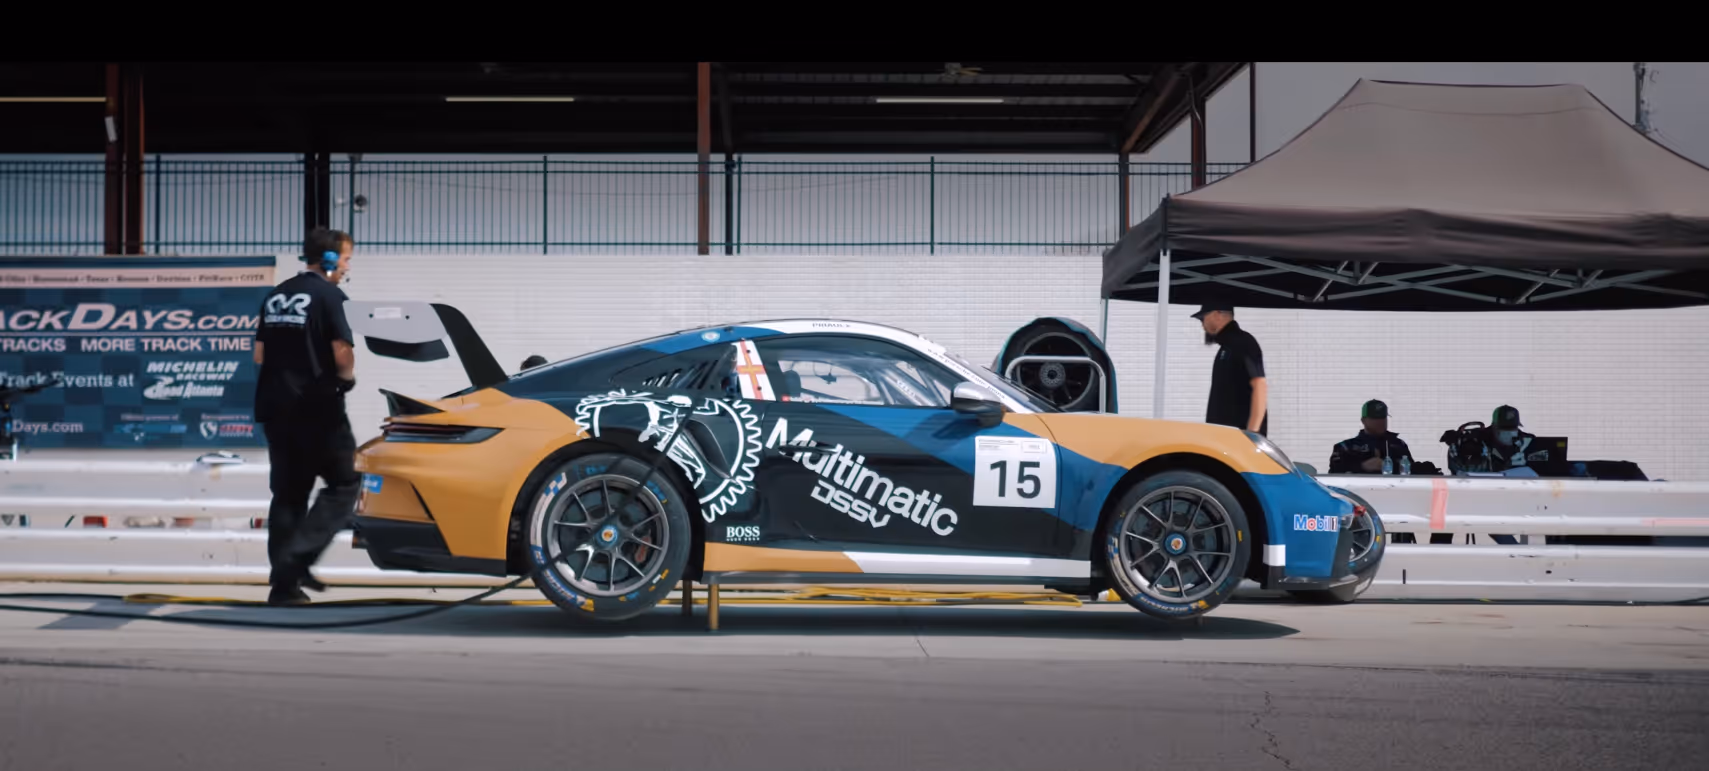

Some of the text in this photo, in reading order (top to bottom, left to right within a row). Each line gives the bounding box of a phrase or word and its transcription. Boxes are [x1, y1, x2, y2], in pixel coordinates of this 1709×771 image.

[0, 336, 252, 353] RACKS MORE TRACK TIME
[146, 361, 239, 373] MICHELIN
[51, 370, 113, 388] Events
[117, 372, 135, 388] at
[176, 373, 235, 381] RACEWAY
[765, 417, 958, 537] Multimatic
[990, 460, 1041, 499] 15
[810, 479, 891, 528] DSSV
[726, 525, 761, 538] BOSS
